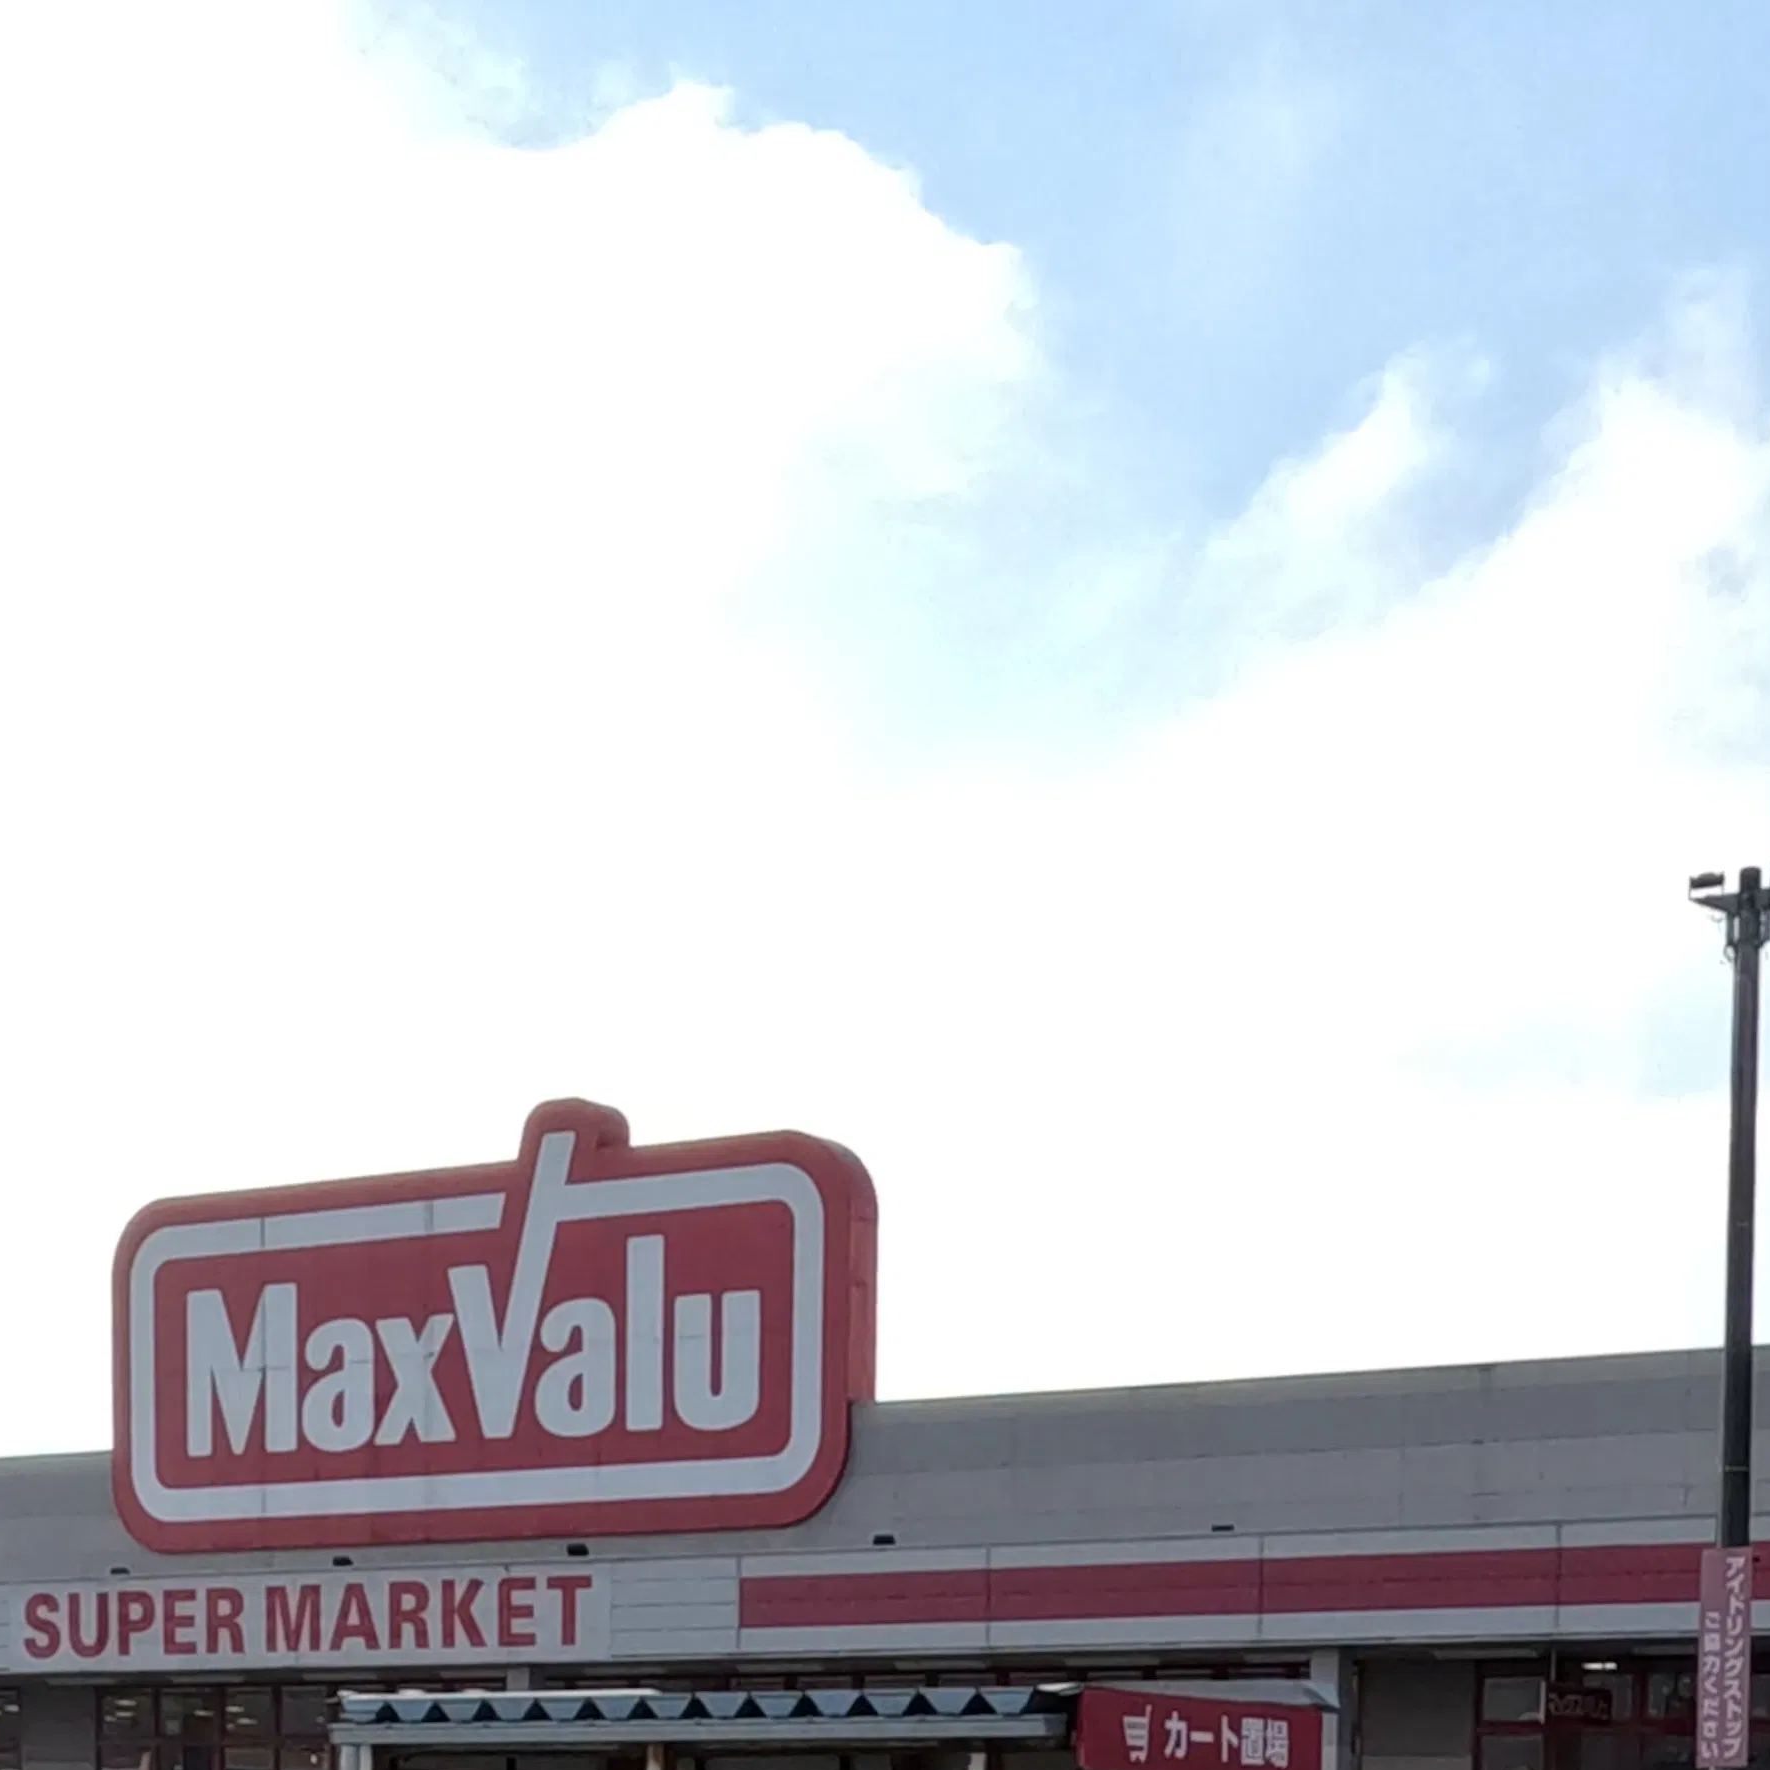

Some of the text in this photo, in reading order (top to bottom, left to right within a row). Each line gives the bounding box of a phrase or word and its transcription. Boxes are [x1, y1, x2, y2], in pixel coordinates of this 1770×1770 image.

[186, 1131, 761, 1459] MaxValu
[24, 1574, 593, 1660] SUPER MARKET
[1722, 1556, 1746, 1760] アイドリングストップ
[1163, 1710, 1290, 1769] カート置場
